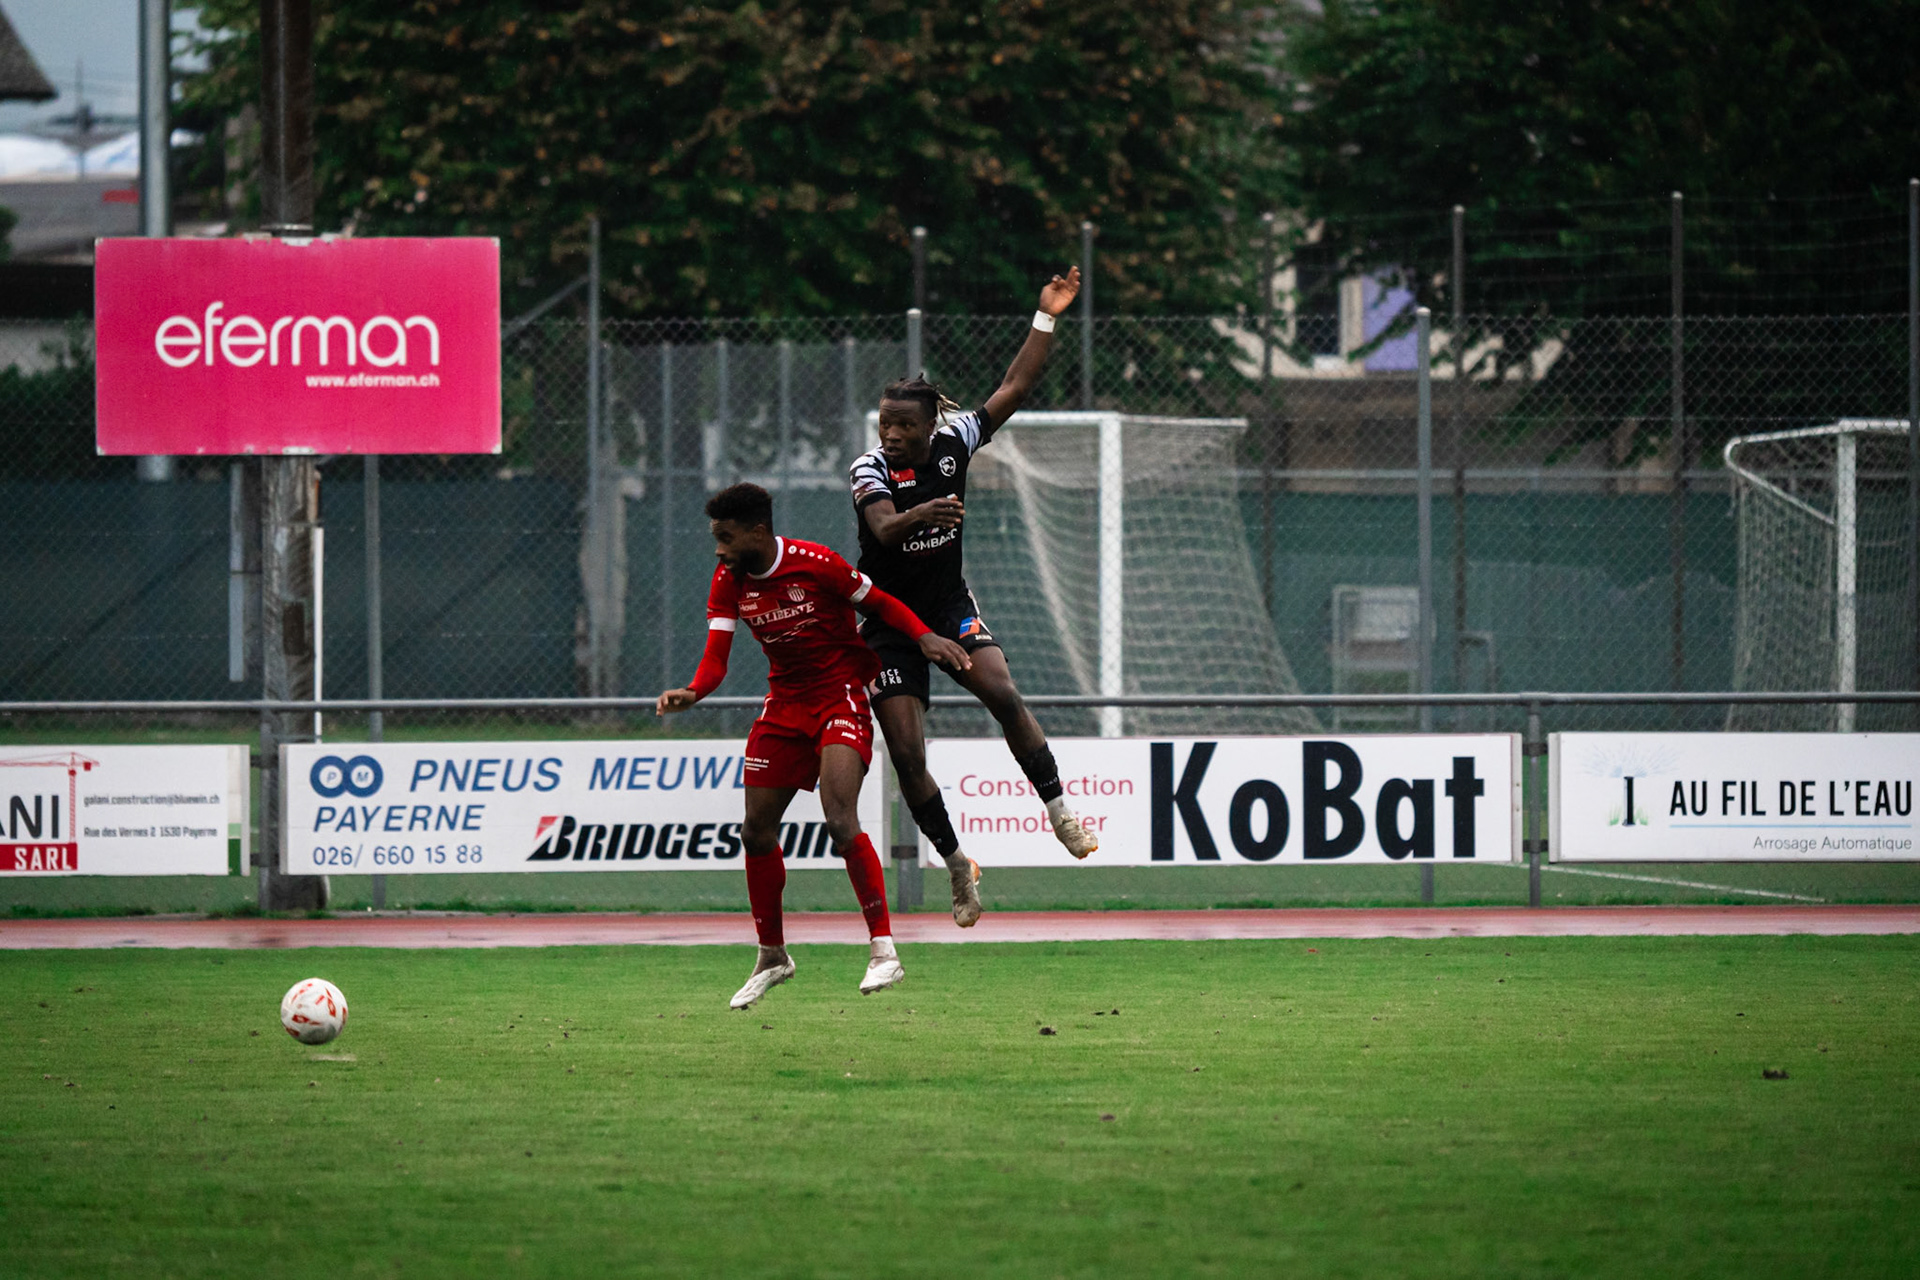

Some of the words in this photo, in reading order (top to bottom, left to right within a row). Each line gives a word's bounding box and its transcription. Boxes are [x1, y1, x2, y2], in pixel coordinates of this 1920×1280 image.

[155, 301, 440, 367] eferman
[306, 373, 440, 387] www.eferman.ch
[898, 480, 917, 489] JAKO
[410, 758, 562, 793] PNEUS
[960, 774, 1133, 797] Constction
[1150, 741, 1485, 862] KoBat
[1669, 781, 1708, 816] AU
[1722, 781, 1767, 816] FIL
[1780, 780, 1816, 816] DE
[0, 795, 60, 840] NI
[313, 805, 486, 832] PAYERNE
[84, 827, 100, 837] Rue
[102, 827, 117, 837] des
[119, 827, 148, 837] Vernes
[183, 826, 217, 838] Payerne
[526, 815, 844, 861] BRIDGESON
[1753, 836, 1817, 852] Arrosage
[1822, 836, 1912, 850] Automatique
[15, 847, 72, 870] SARL
[373, 845, 415, 865] 660
[425, 845, 446, 864] 15
[456, 845, 483, 863] 88
